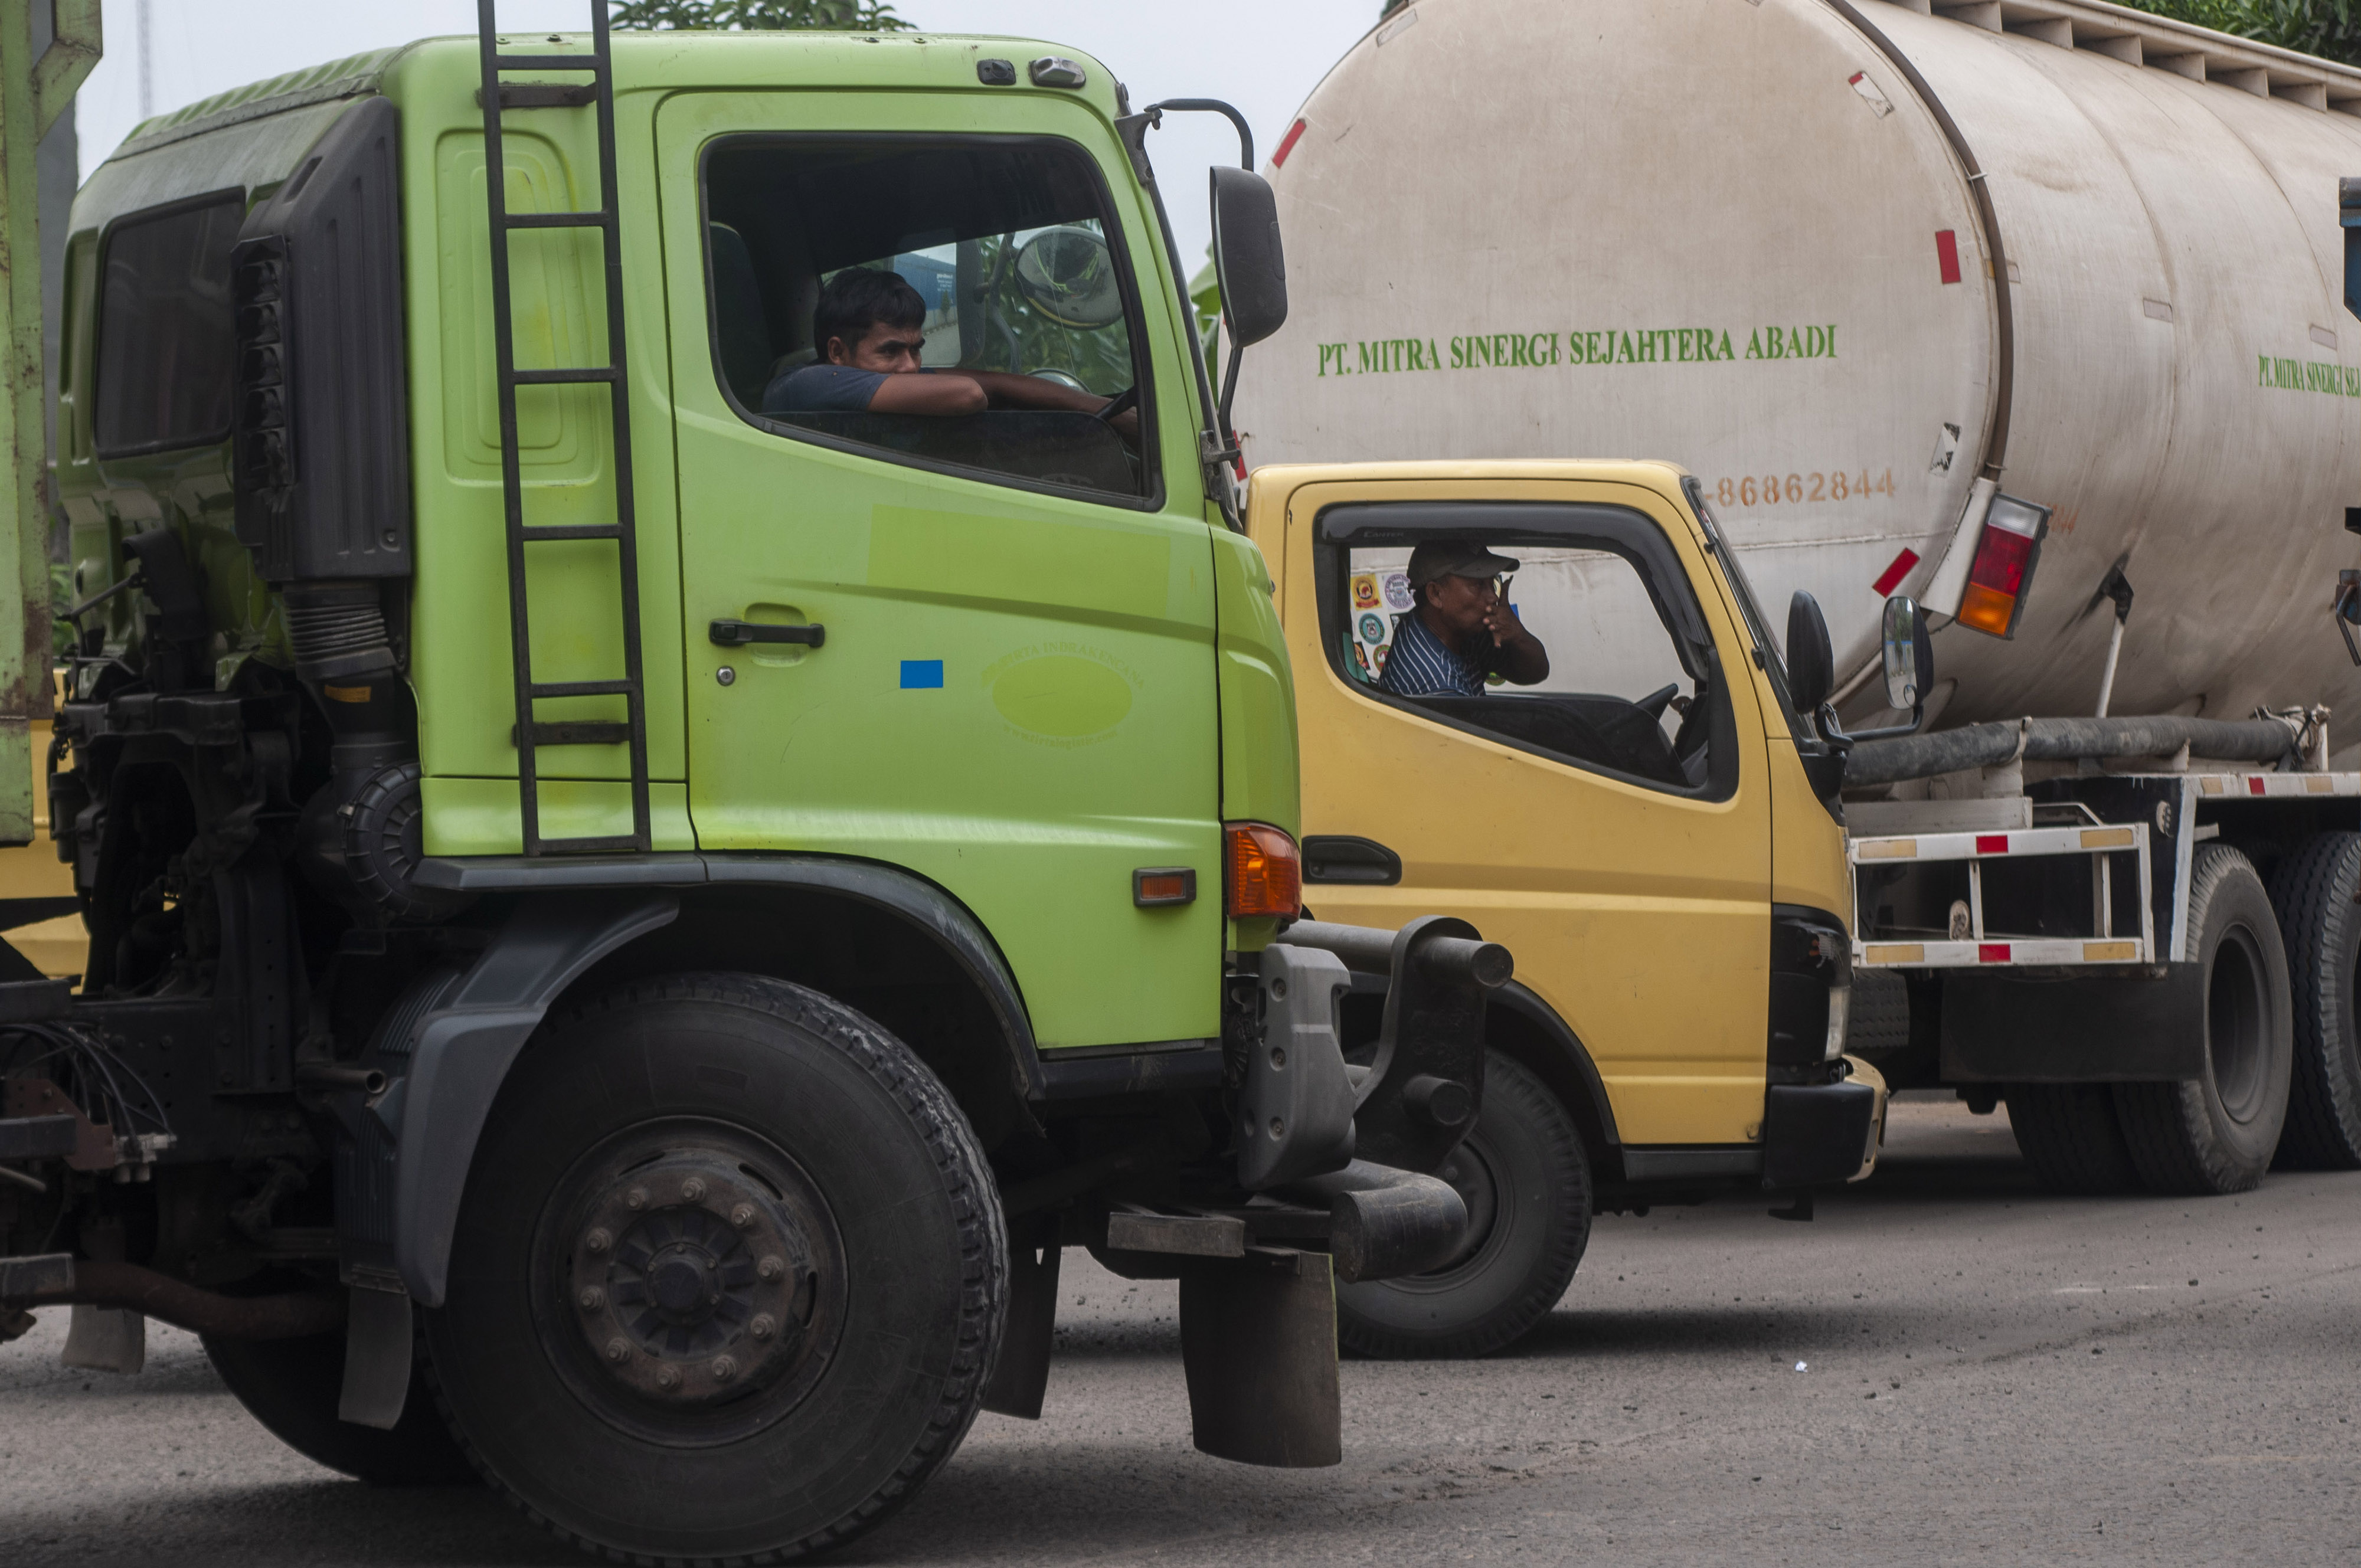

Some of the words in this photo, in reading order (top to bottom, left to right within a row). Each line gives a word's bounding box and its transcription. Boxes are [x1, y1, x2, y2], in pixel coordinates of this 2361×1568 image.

[1317, 343, 1352, 377] PT.
[1358, 339, 1441, 374] MITRA
[1450, 333, 1560, 369] SINERGI
[1569, 329, 1736, 365] SEJAHTERA
[1745, 325, 1837, 359] ABADI
[2258, 355, 2272, 387] PT.
[2274, 356, 2305, 391] MITRA
[2307, 361, 2343, 395] SINERGI
